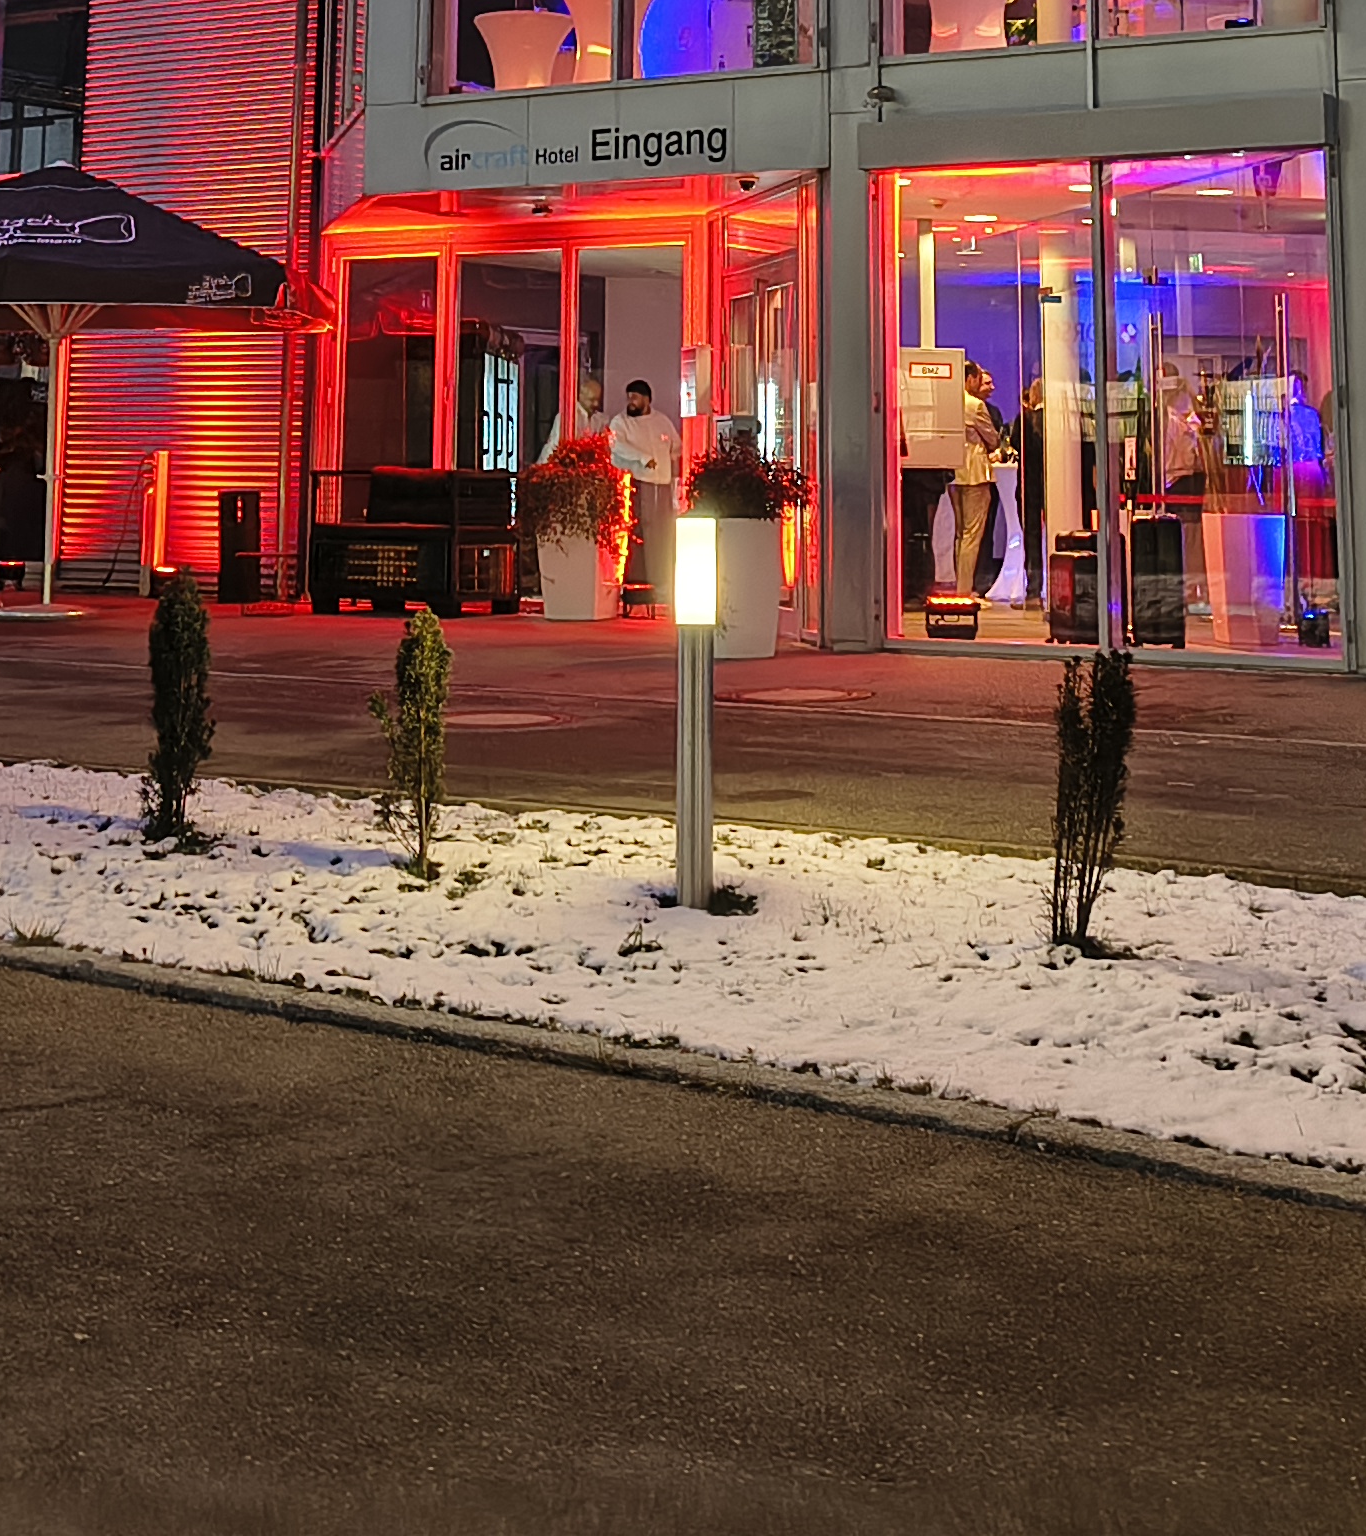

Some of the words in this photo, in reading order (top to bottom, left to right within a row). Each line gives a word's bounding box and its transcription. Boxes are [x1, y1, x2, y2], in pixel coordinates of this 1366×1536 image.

[440, 143, 528, 171] aircraft
[535, 145, 579, 166] Hotel
[590, 126, 728, 167] Eingang
